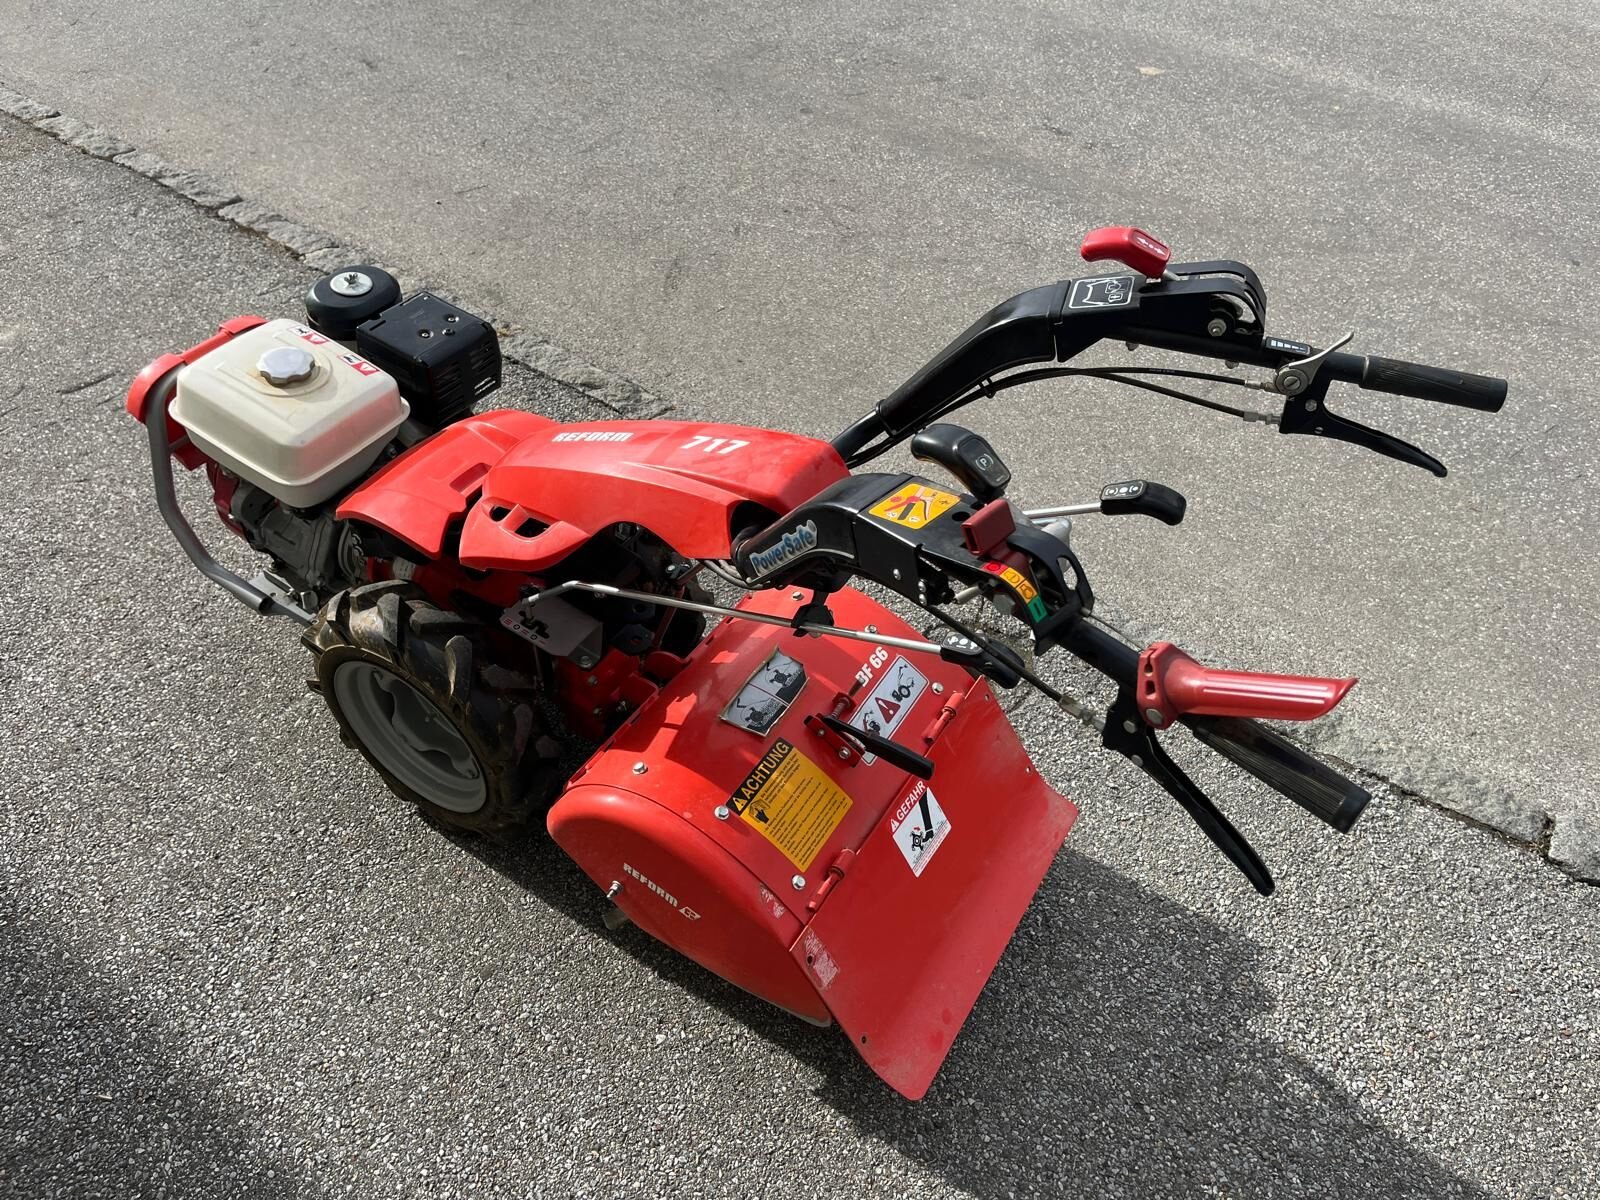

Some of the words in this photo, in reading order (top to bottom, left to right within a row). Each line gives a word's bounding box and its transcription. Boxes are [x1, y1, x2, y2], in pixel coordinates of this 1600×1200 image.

[552, 431, 634, 442] REFORM
[680, 435, 750, 455] 717
[751, 527, 815, 573] PowerSafe
[869, 646, 889, 669] 66
[741, 742, 790, 799] ACHTUNG
[896, 780, 926, 820] GEFAHR
[623, 862, 679, 908] REFORM
